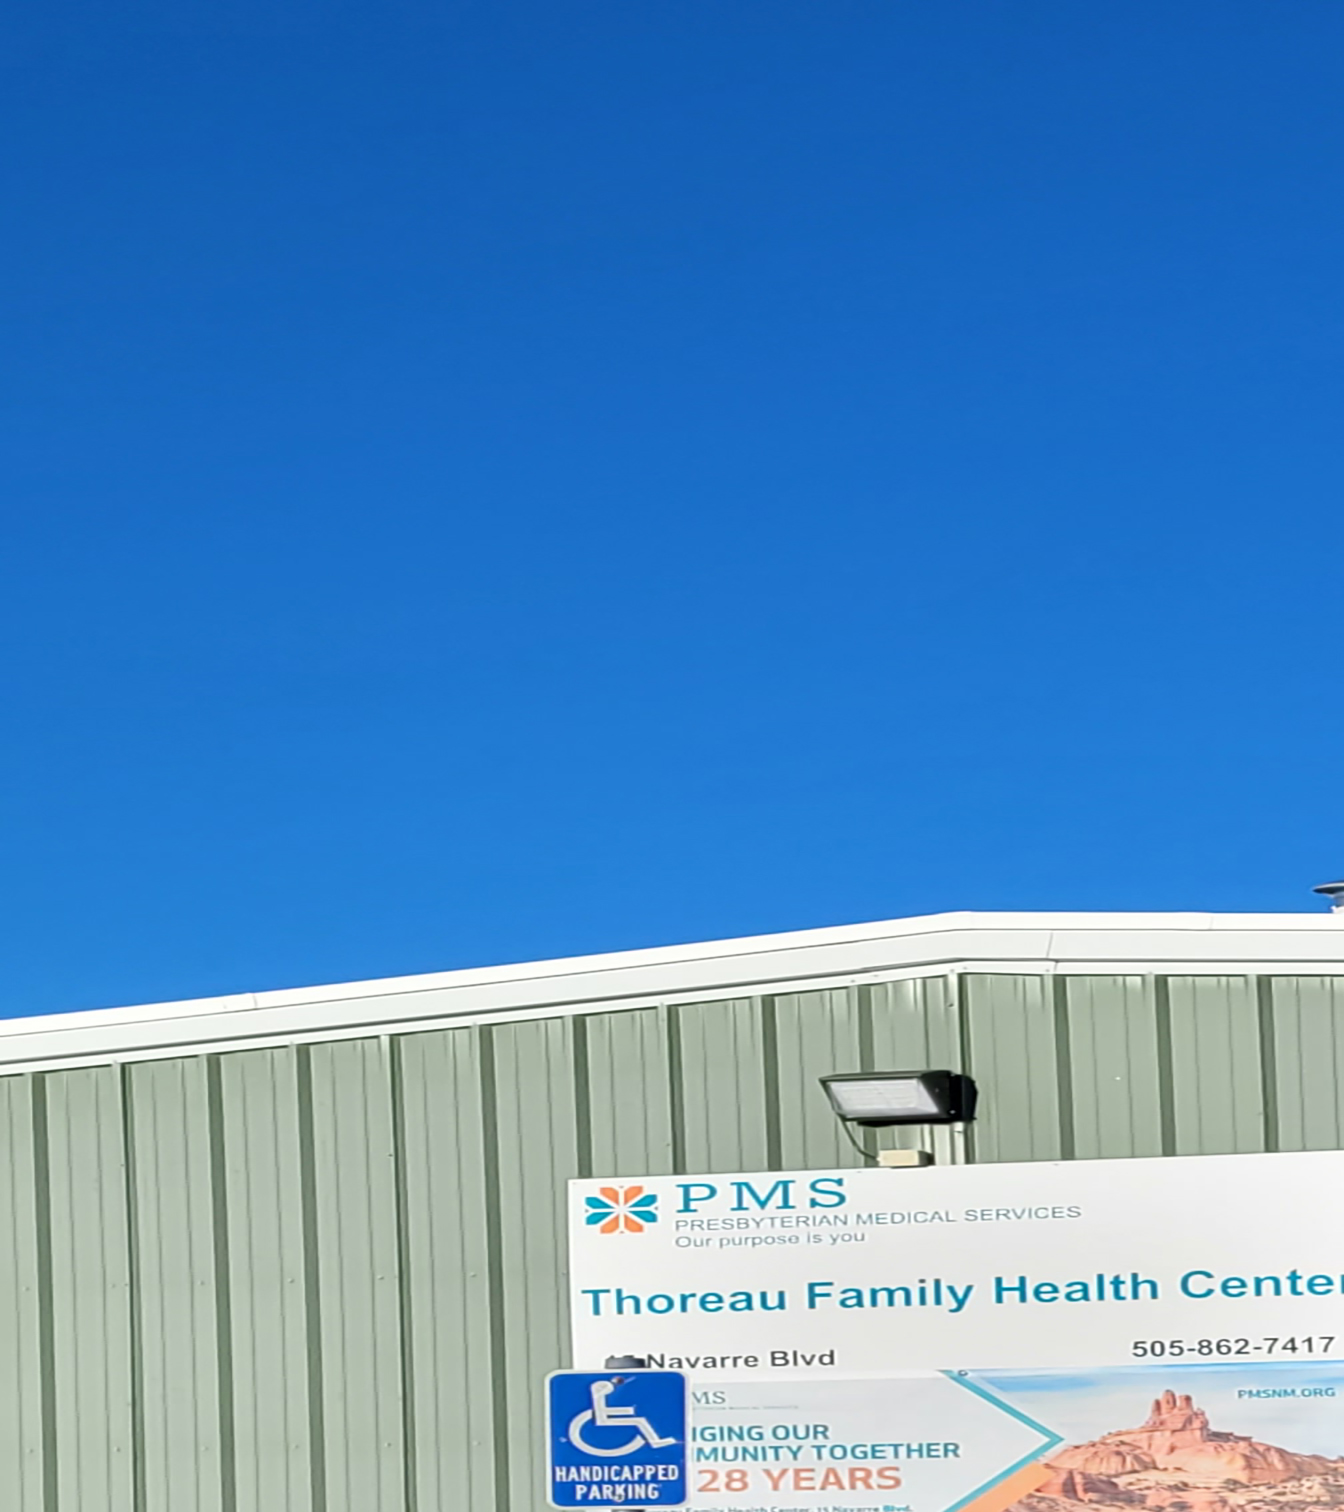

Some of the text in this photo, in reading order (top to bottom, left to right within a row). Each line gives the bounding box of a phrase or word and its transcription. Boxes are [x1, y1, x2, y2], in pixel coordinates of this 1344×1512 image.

[675, 1178, 847, 1213] PMS
[675, 1206, 1082, 1231] PRESBYTERIAN MEDICAL SERVICES
[675, 1231, 865, 1249] Our purpose is you
[581, 1288, 787, 1316] Thoreau
[807, 1278, 973, 1313] Family
[994, 1272, 1159, 1304] Health
[1131, 1336, 1336, 1357] 505-862-7417
[646, 1353, 759, 1369] Navarre
[770, 1350, 836, 1368] Blvd
[692, 1390, 726, 1405] MS
[1237, 1387, 1336, 1399] PMSNM.ORG
[692, 1424, 830, 1442] GING OUR
[695, 1442, 961, 1463] MUNITY TOGETHER
[555, 1464, 679, 1482] HANDICAPPED
[697, 1466, 902, 1492] 28 YEARS
[575, 1483, 660, 1500] PARKING
